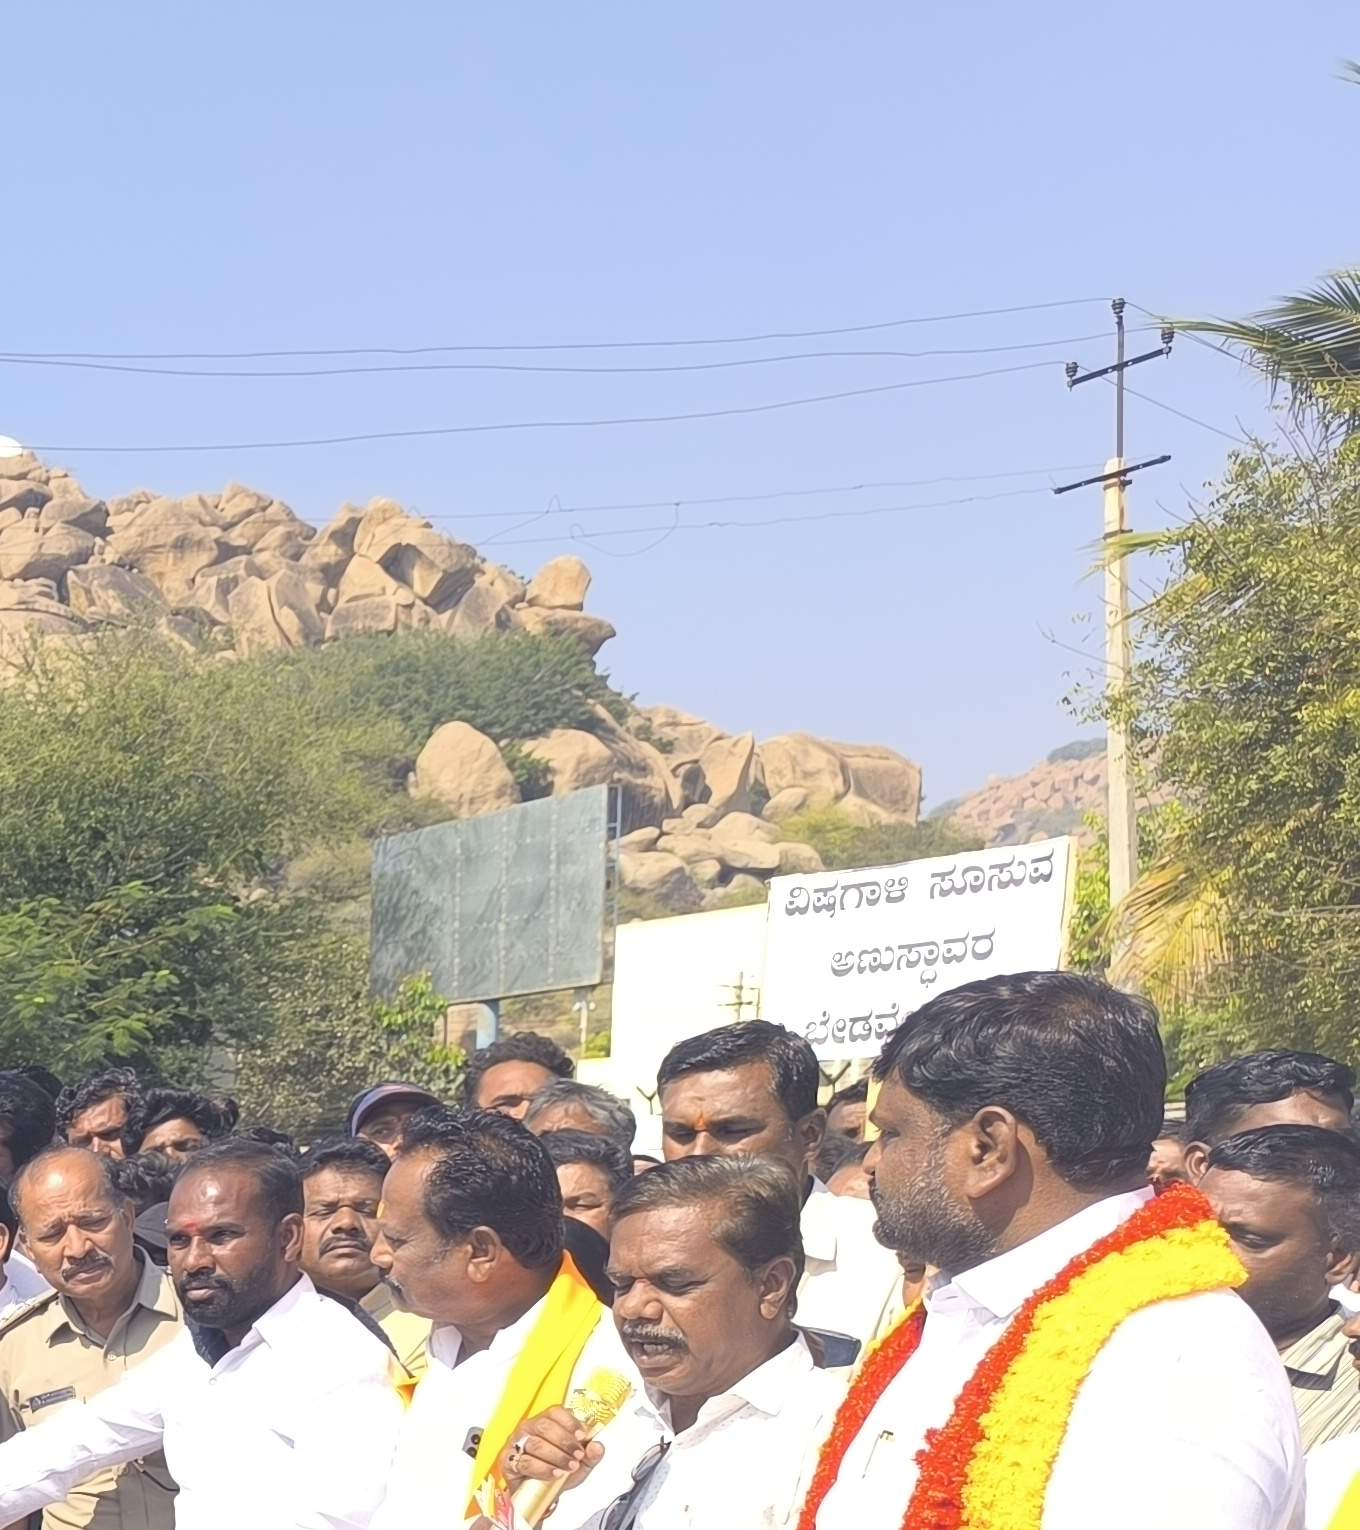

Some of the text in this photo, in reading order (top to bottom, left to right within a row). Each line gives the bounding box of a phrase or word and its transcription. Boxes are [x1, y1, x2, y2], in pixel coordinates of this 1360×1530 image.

[785, 848, 1054, 918] ವಿಷಗಾಳಿ ಸೂಸುವ
[830, 928, 996, 988] ಅಣುಸ್ಥಾವರ
